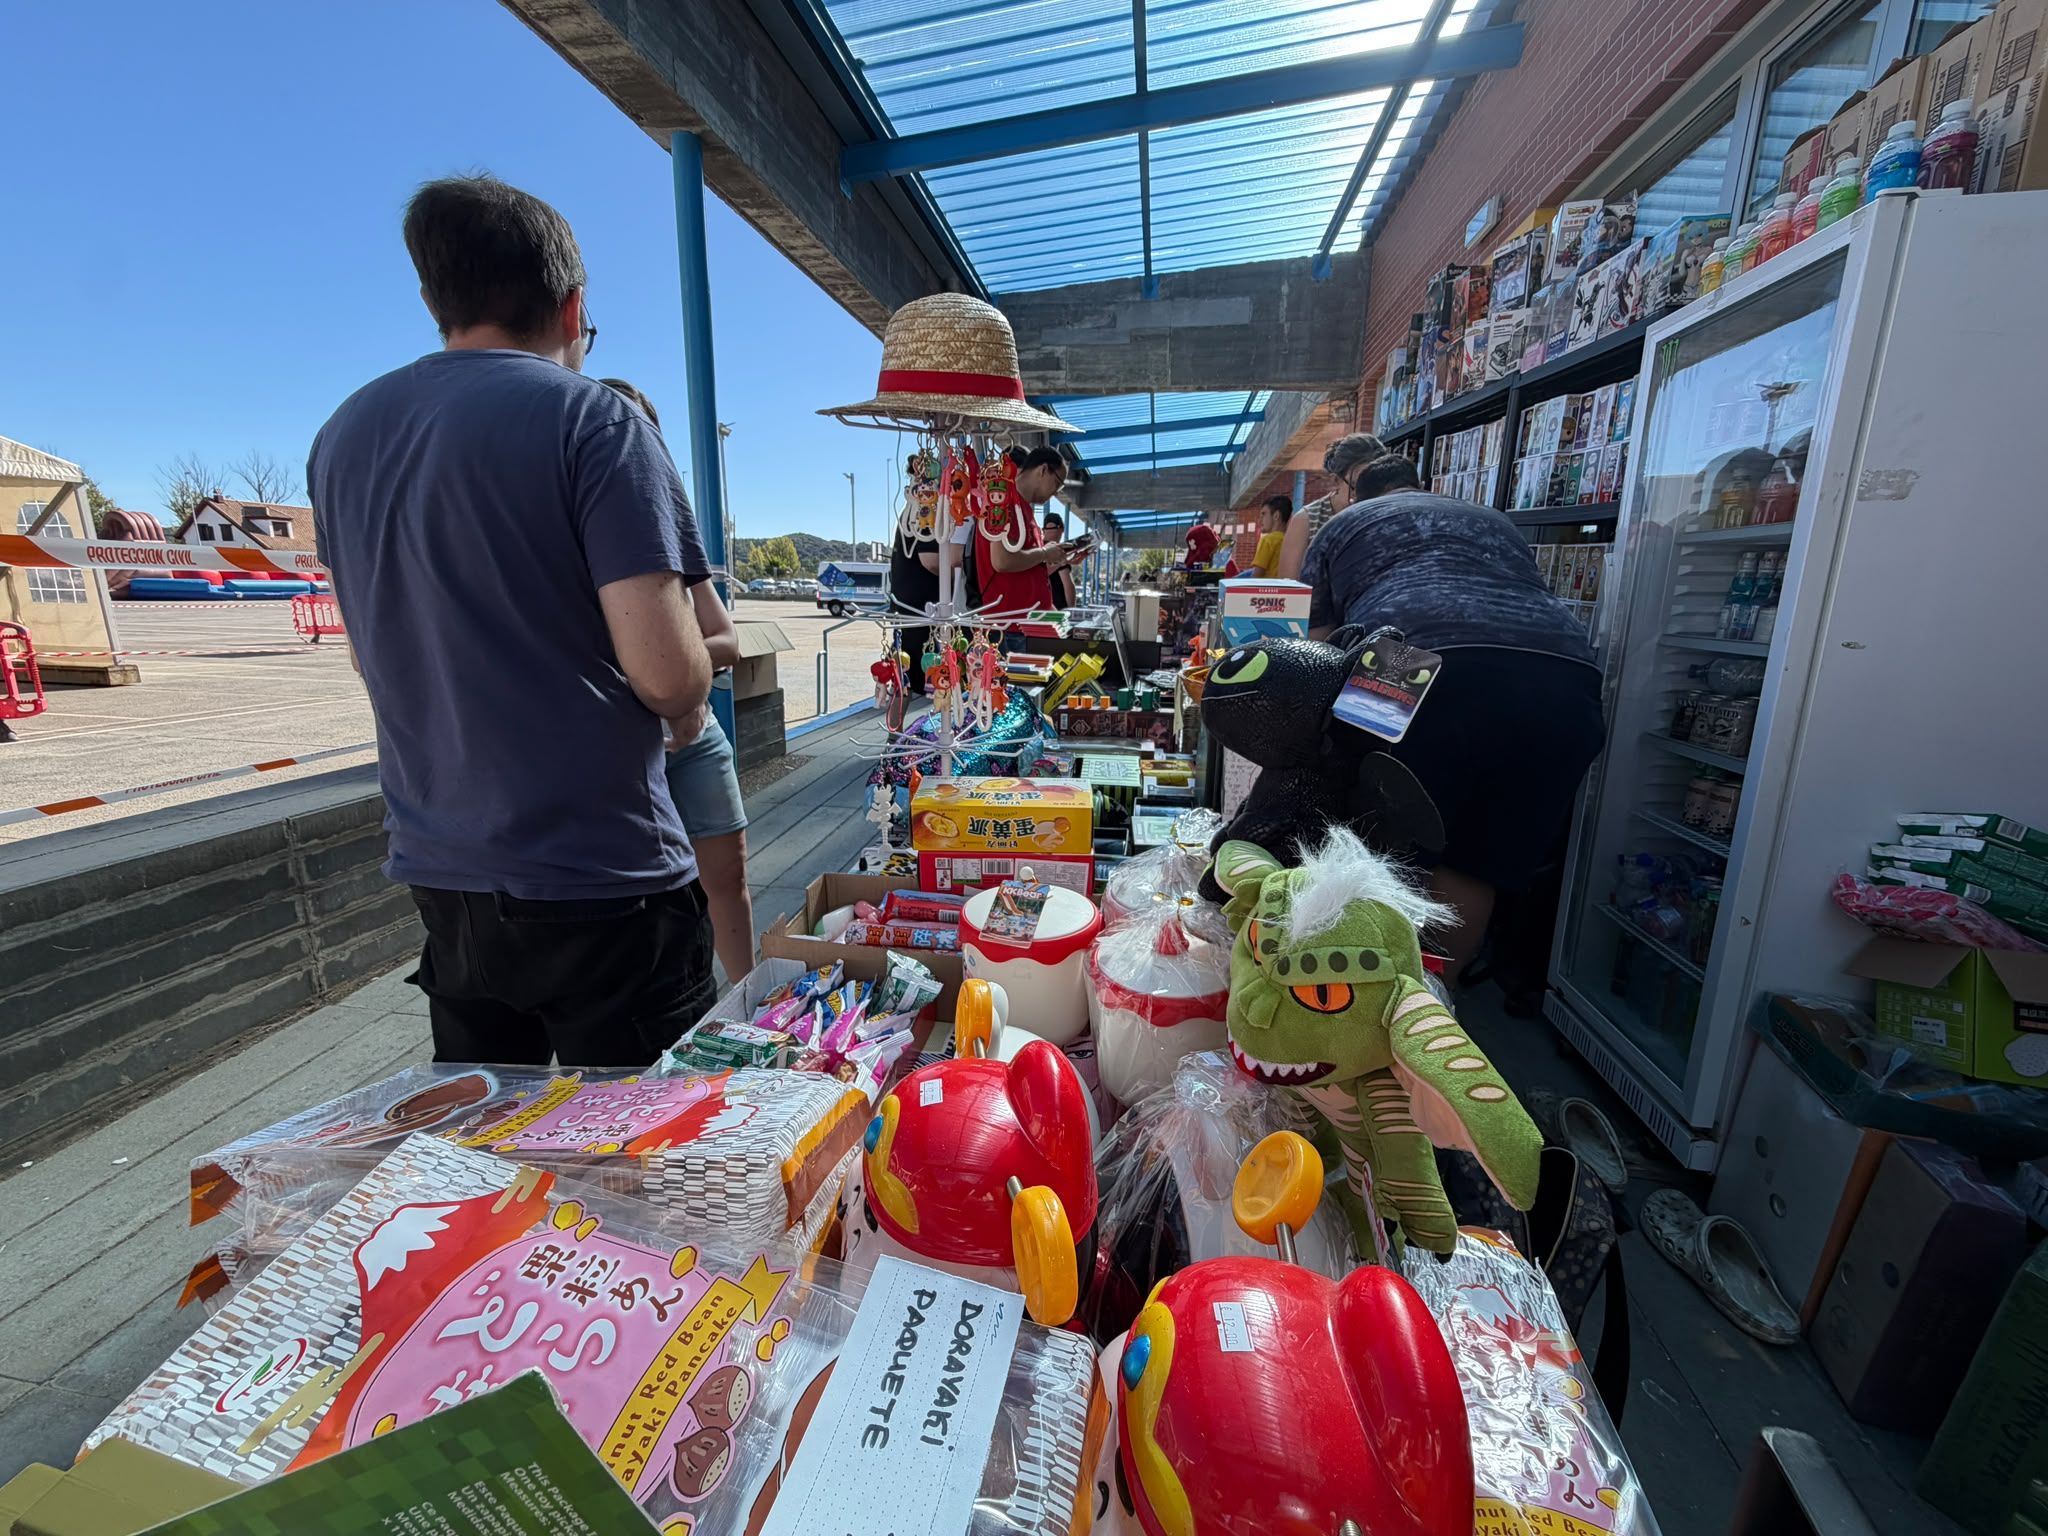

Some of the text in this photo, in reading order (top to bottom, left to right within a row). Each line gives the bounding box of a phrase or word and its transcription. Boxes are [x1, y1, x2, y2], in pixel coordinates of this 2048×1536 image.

[86, 545, 197, 567] PROTECCION CIVIL
[1249, 597, 1287, 607] SONIC
[967, 815, 1036, 839] 蛋黄派
[639, 1353, 678, 1400] Red
[676, 1295, 724, 1346] Bean
[664, 1306, 738, 1397] Pancake
[861, 1288, 938, 1450] PAQUETE
[461, 1486, 478, 1503] Un
[474, 1480, 498, 1504] Este
[514, 1467, 536, 1491] One
[534, 1489, 554, 1510] toy
[528, 1461, 589, 1532] This Package
[408, 1506, 431, 1528] Une
[421, 1501, 437, 1516] Ce
